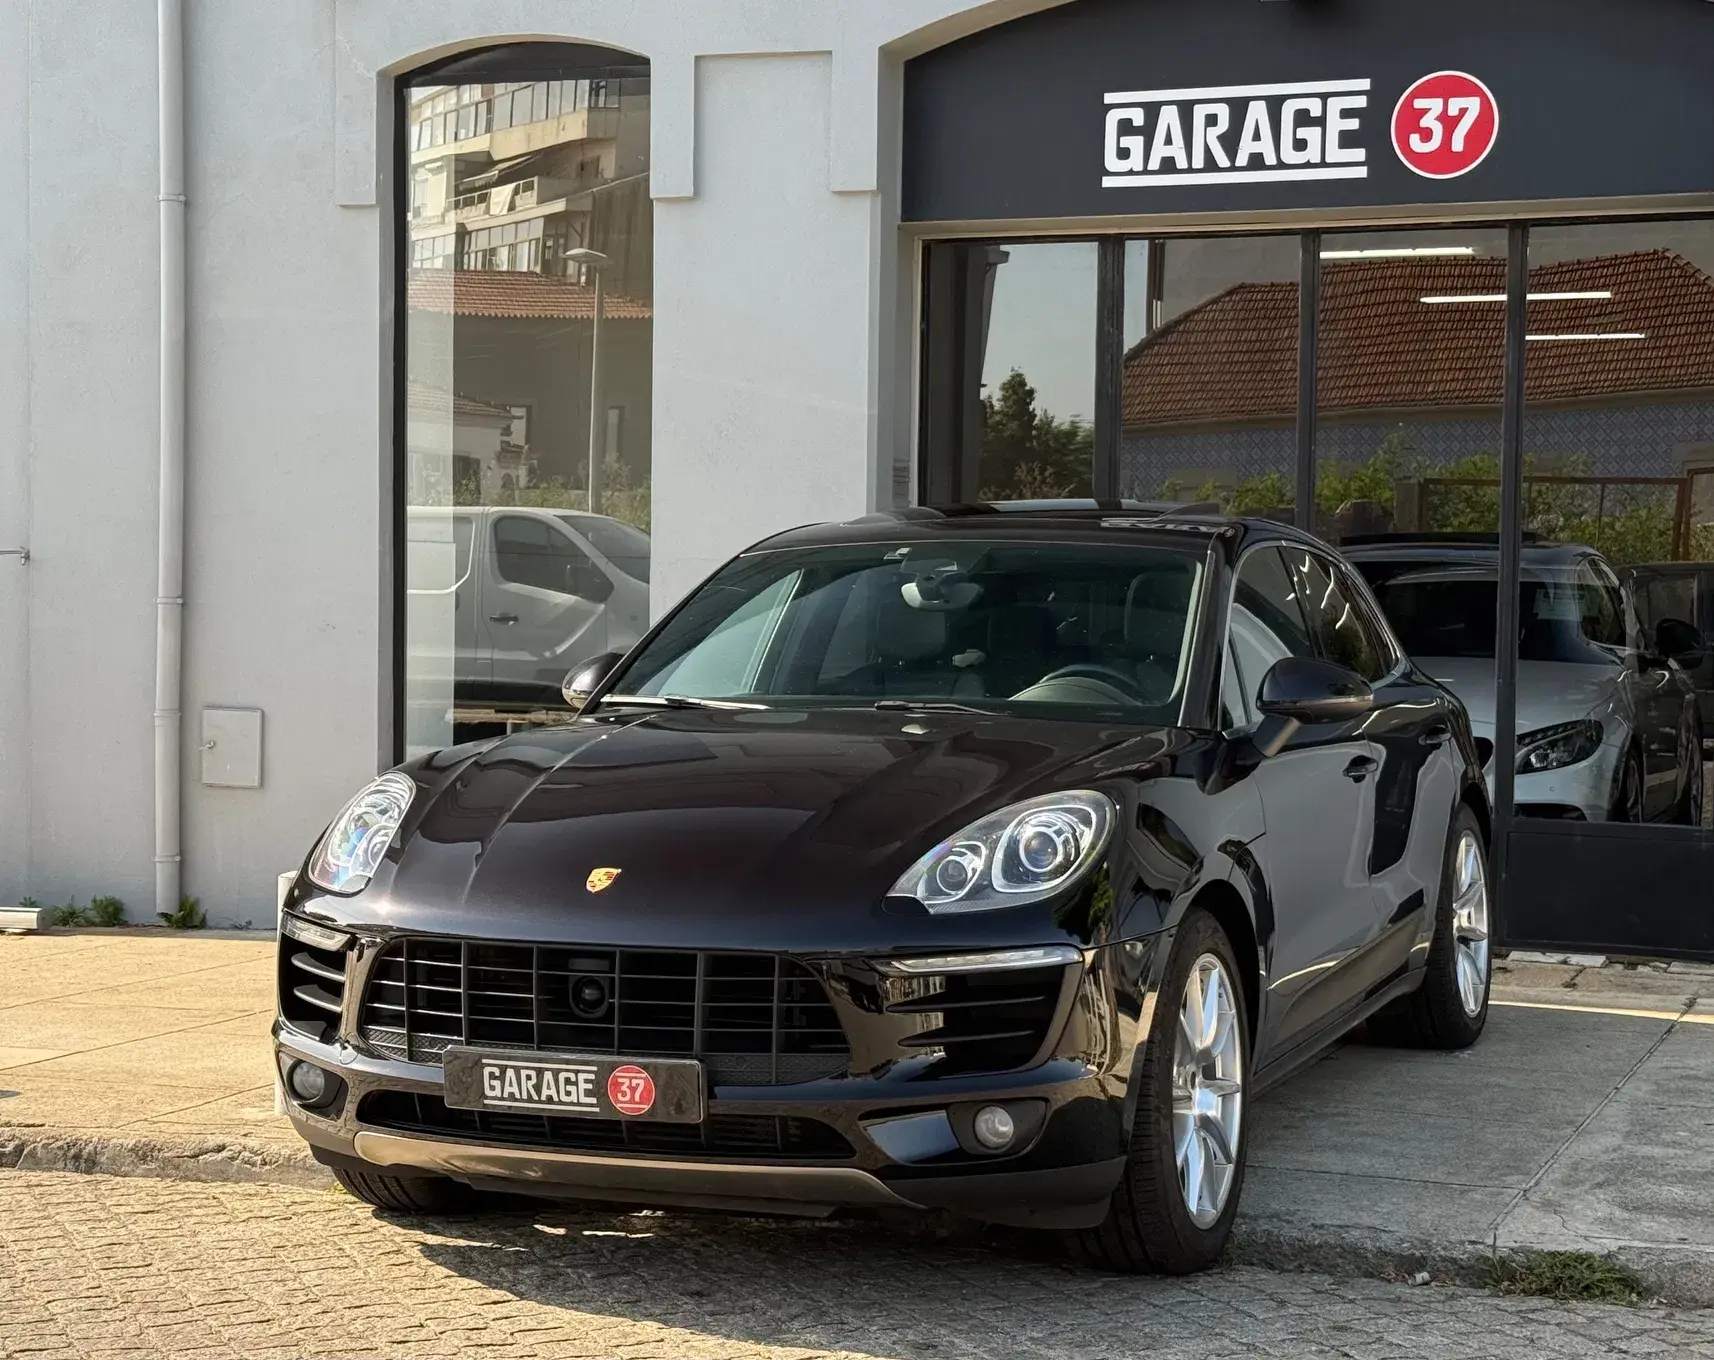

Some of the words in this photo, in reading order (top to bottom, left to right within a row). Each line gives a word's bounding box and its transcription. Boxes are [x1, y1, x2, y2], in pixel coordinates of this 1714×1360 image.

[1104, 95, 1367, 172] GARAGE
[1409, 97, 1481, 154] 37
[483, 1066, 598, 1104] GARAGE
[616, 1078, 646, 1102] 37
